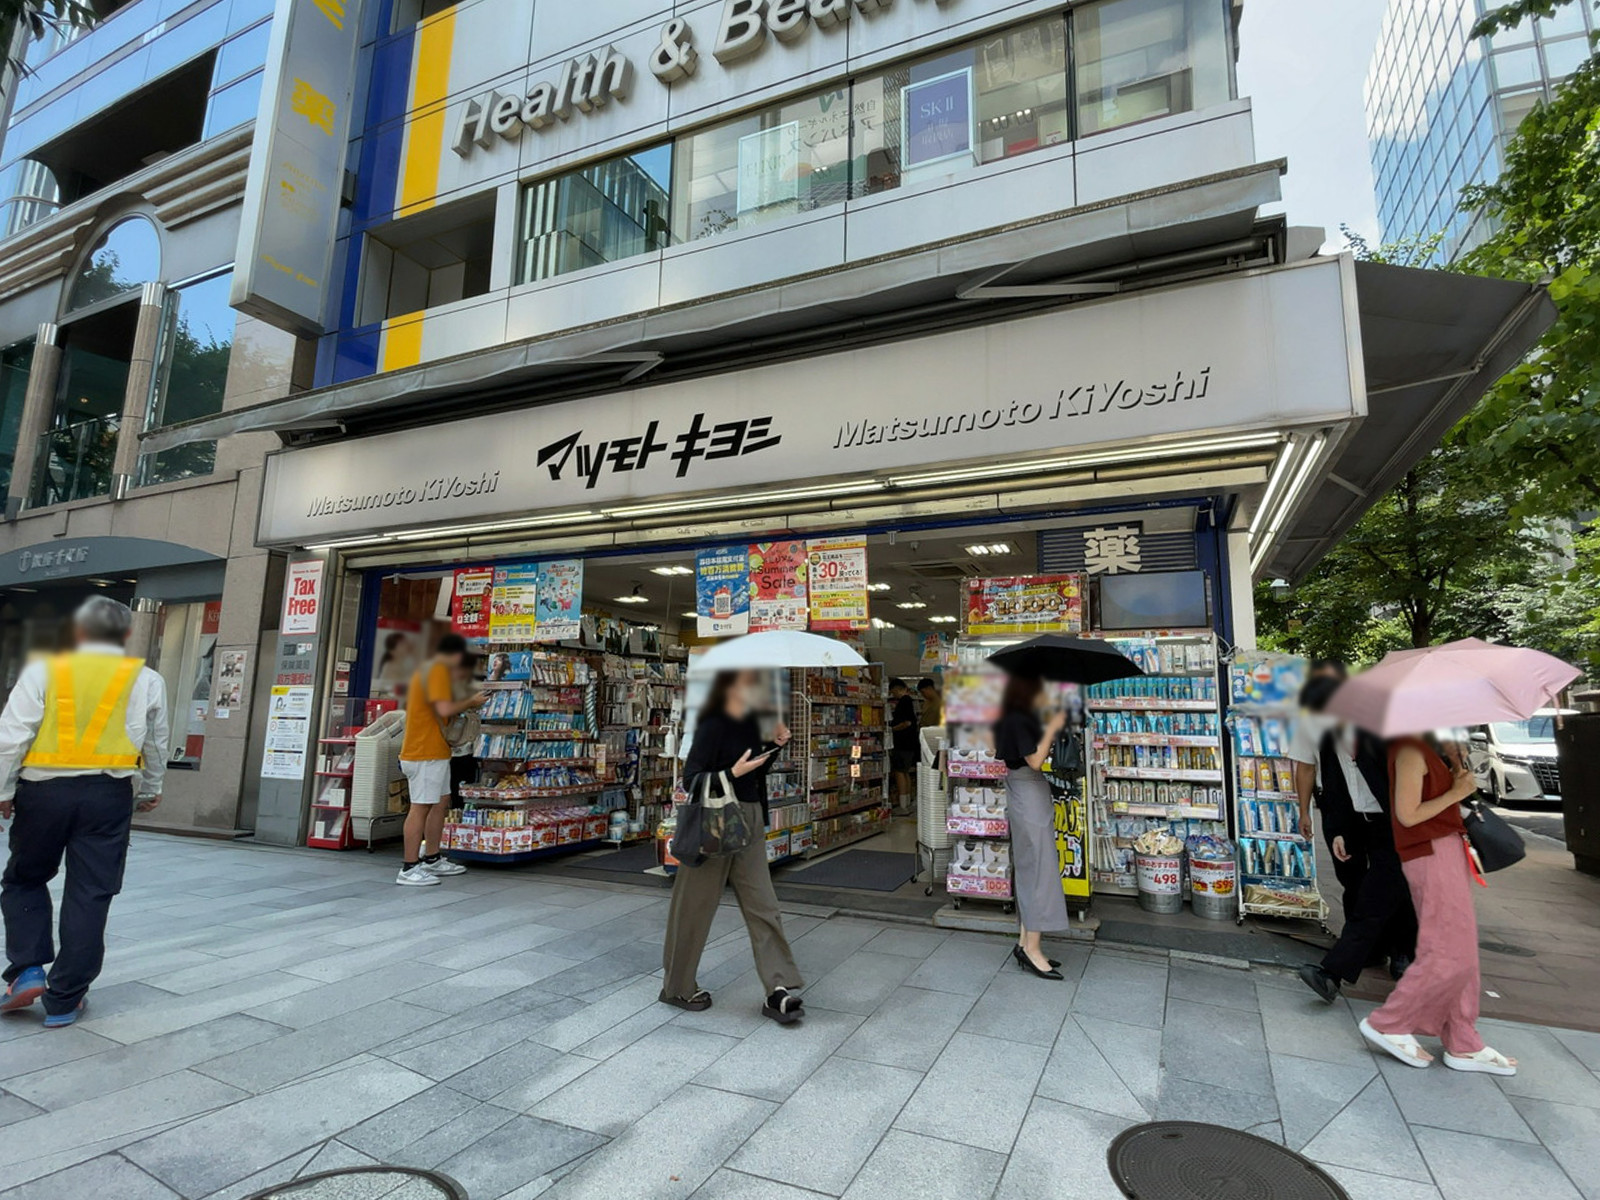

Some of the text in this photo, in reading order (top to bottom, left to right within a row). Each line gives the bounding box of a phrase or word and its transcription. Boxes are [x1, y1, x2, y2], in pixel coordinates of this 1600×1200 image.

[452, 44, 634, 158] Health
[649, 16, 698, 83] &
[832, 366, 1212, 449] Matsumoto KiYoshi
[537, 413, 782, 489] マツモトキヨシ
[306, 470, 500, 518] Matsumoto KiYoshi
[1082, 526, 1143, 574] 薬
[293, 577, 316, 596] Tax
[761, 575, 796, 589] Sale
[288, 598, 316, 616] Free
[1153, 872, 1177, 885] 498
